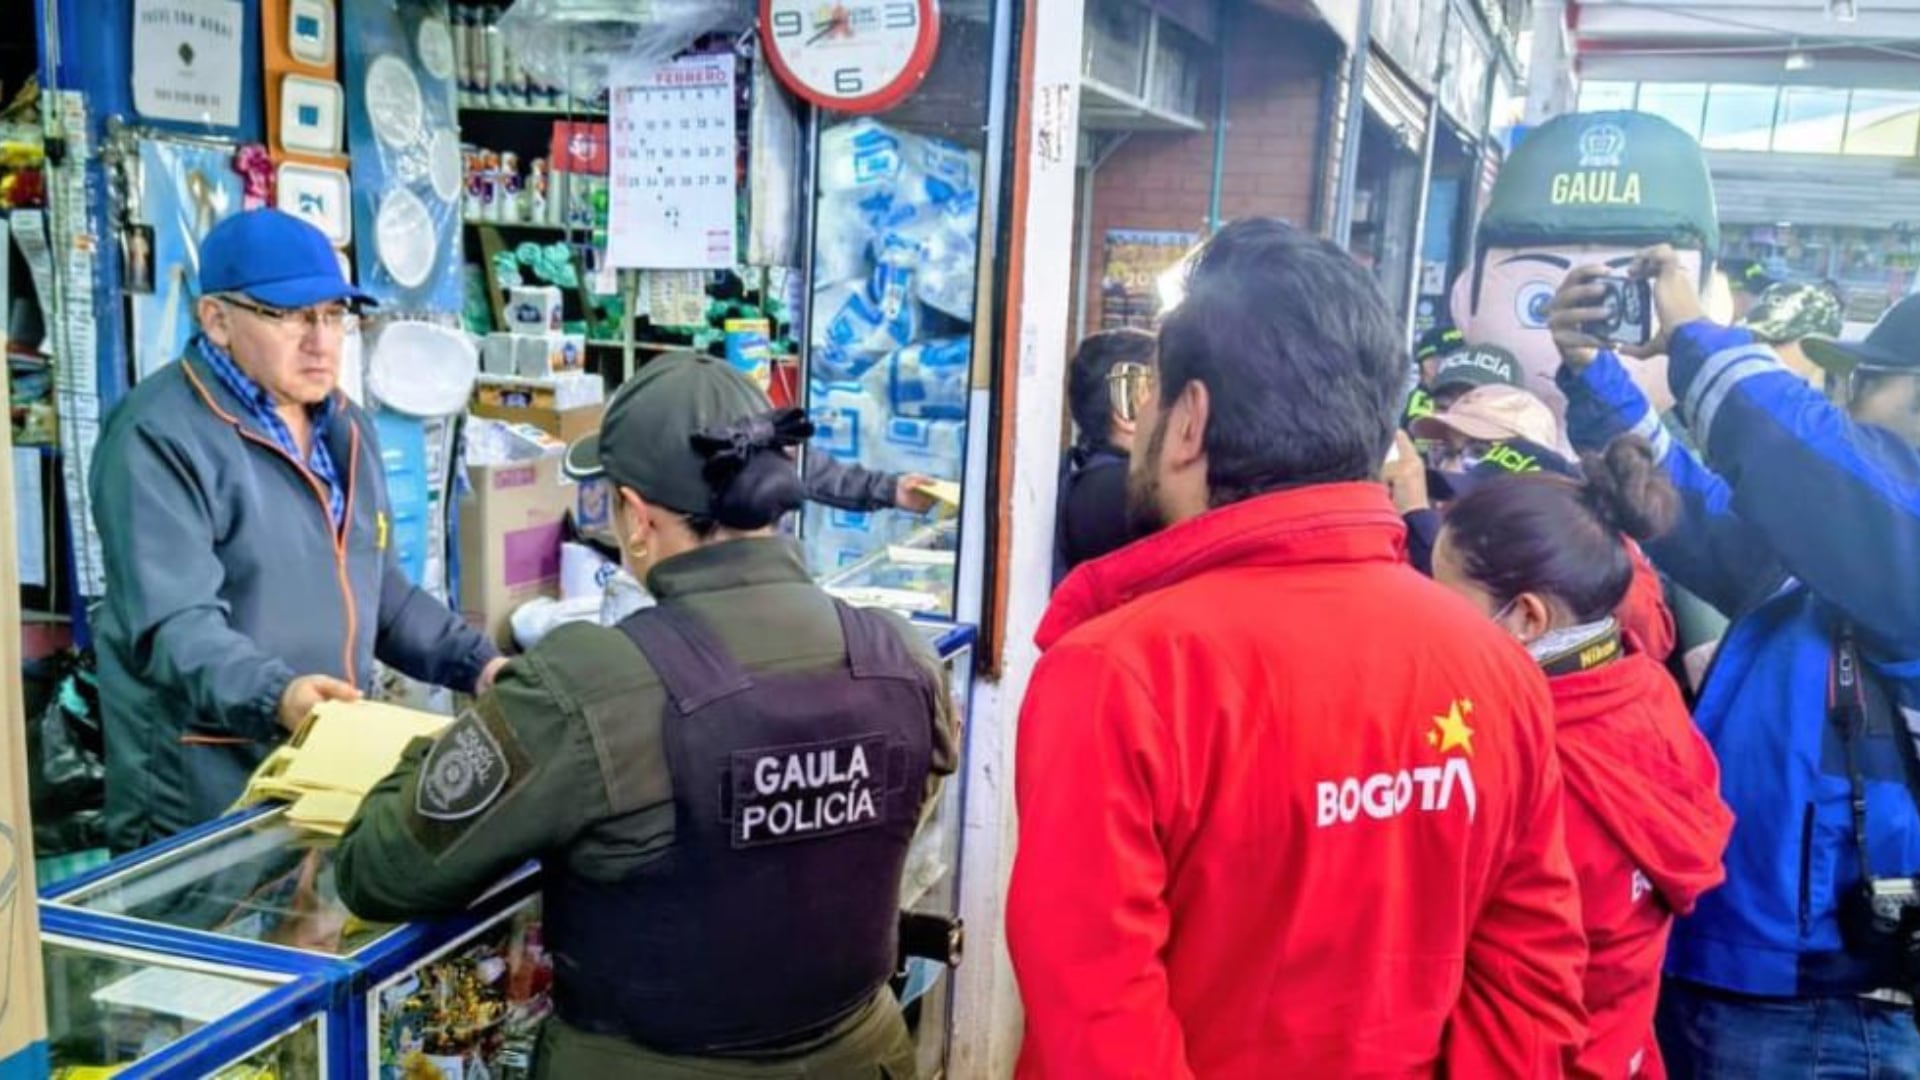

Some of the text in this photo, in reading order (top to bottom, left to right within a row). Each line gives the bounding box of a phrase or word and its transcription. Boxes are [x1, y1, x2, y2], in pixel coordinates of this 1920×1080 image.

[774, 10, 802, 37] 9
[885, 3, 916, 28] 3
[655, 67, 727, 85] FEBRERO
[834, 67, 863, 93] 6
[1551, 171, 1641, 204] GAULA
[754, 744, 869, 796] GAULA
[742, 778, 876, 840] POLICÍA
